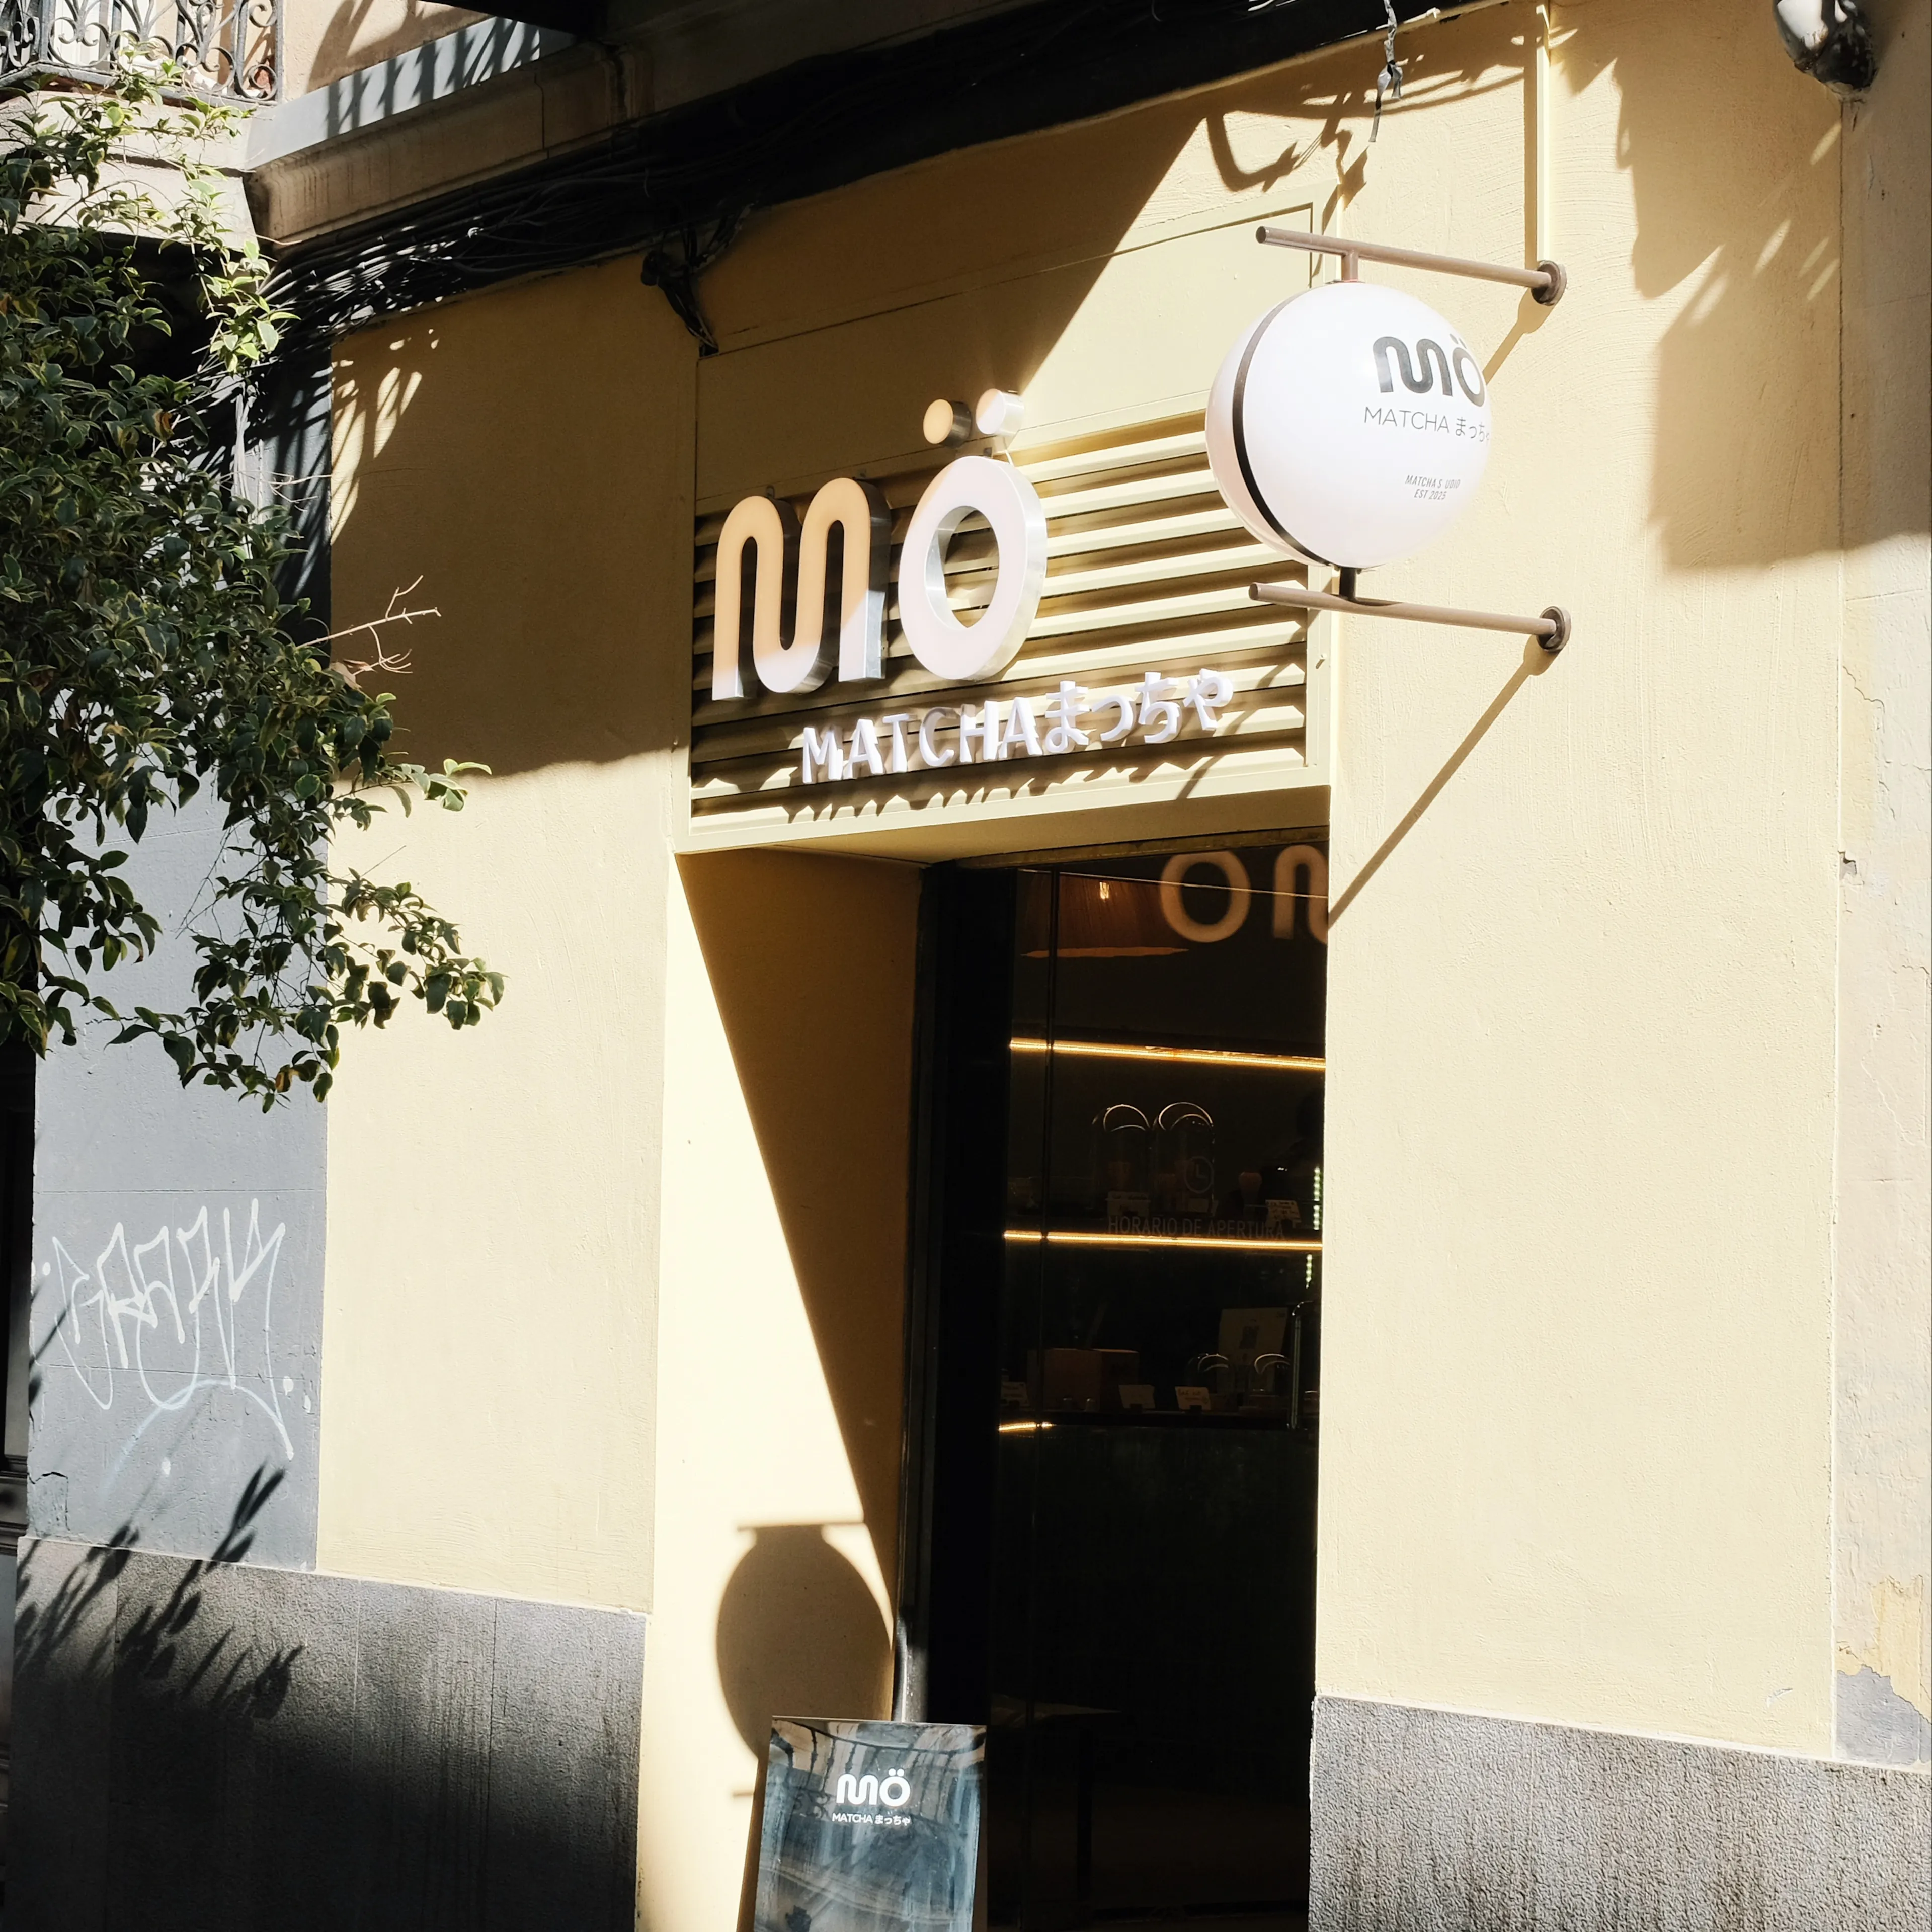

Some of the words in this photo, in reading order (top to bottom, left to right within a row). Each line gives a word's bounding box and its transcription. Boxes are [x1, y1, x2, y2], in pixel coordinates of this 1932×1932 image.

[1364, 407, 1449, 433] MATCHA
[1405, 475, 1436, 488] MATCHA
[1437, 479, 1461, 489] SUDIO
[1414, 489, 1428, 498] EST
[1428, 491, 1447, 500] 2025
[711, 388, 1048, 701] MÖ
[1108, 1216, 1177, 1236] HORARIO
[1182, 1218, 1202, 1236] DE
[1208, 1219, 1286, 1240] APERTURA
[836, 1768, 911, 1807] MÖ
[832, 1813, 873, 1824] MATCHA
